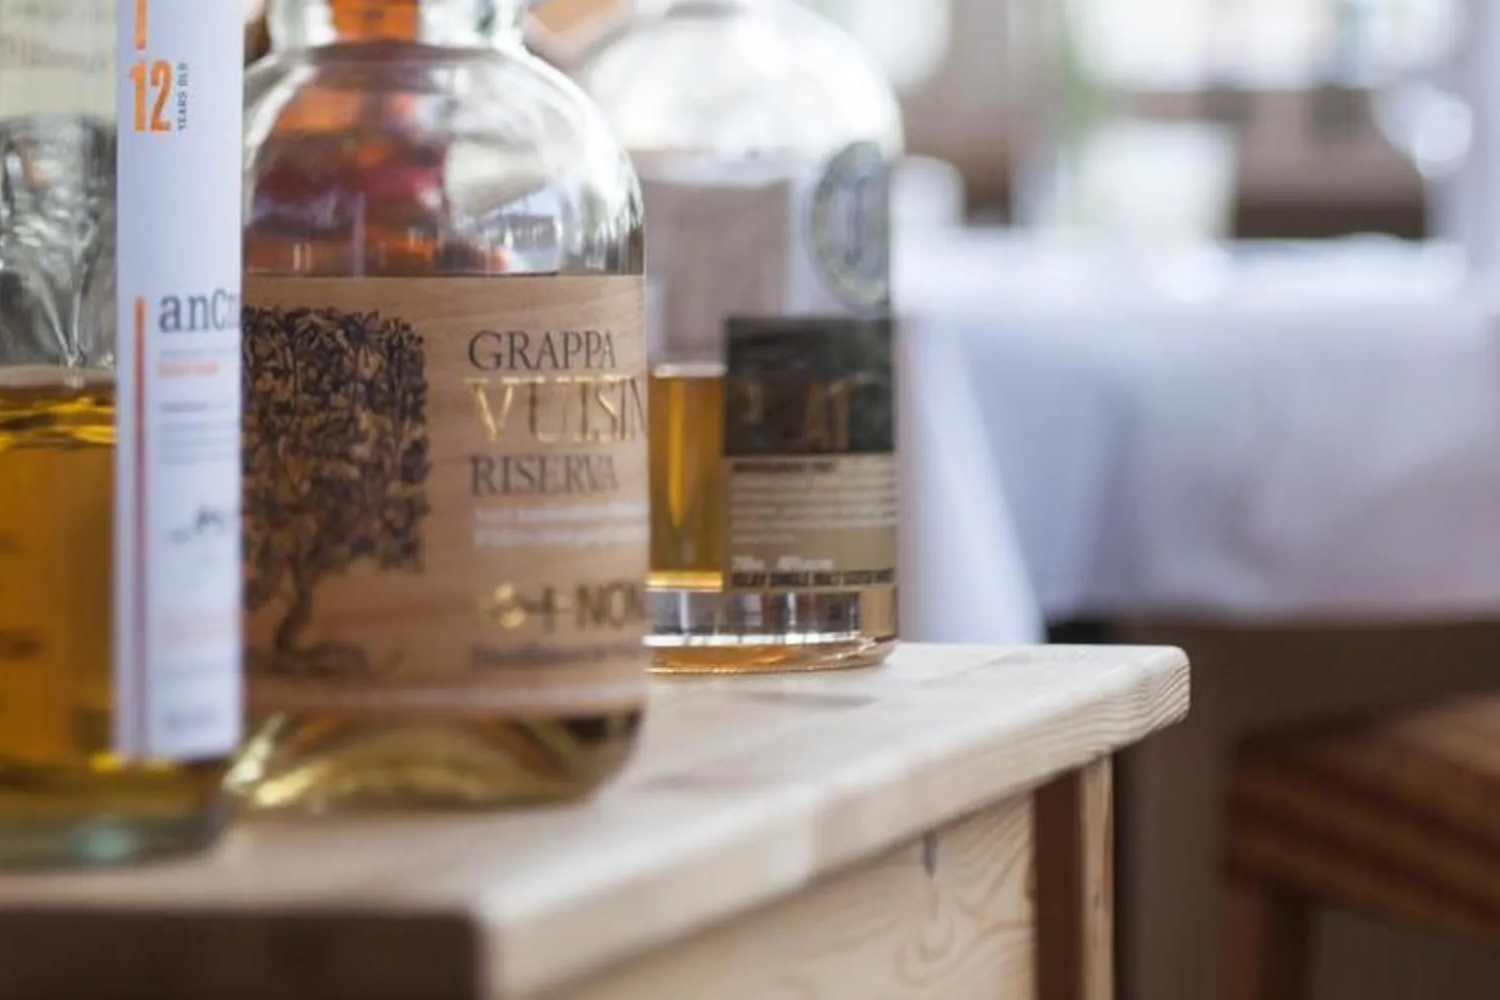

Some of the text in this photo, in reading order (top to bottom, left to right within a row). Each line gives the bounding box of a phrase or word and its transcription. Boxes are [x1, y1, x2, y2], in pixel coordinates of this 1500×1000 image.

[130, 60, 172, 132] 12
[176, 91, 189, 132] YEARS
[467, 329, 618, 371] GRAPPA
[468, 452, 620, 497] RISERVA
